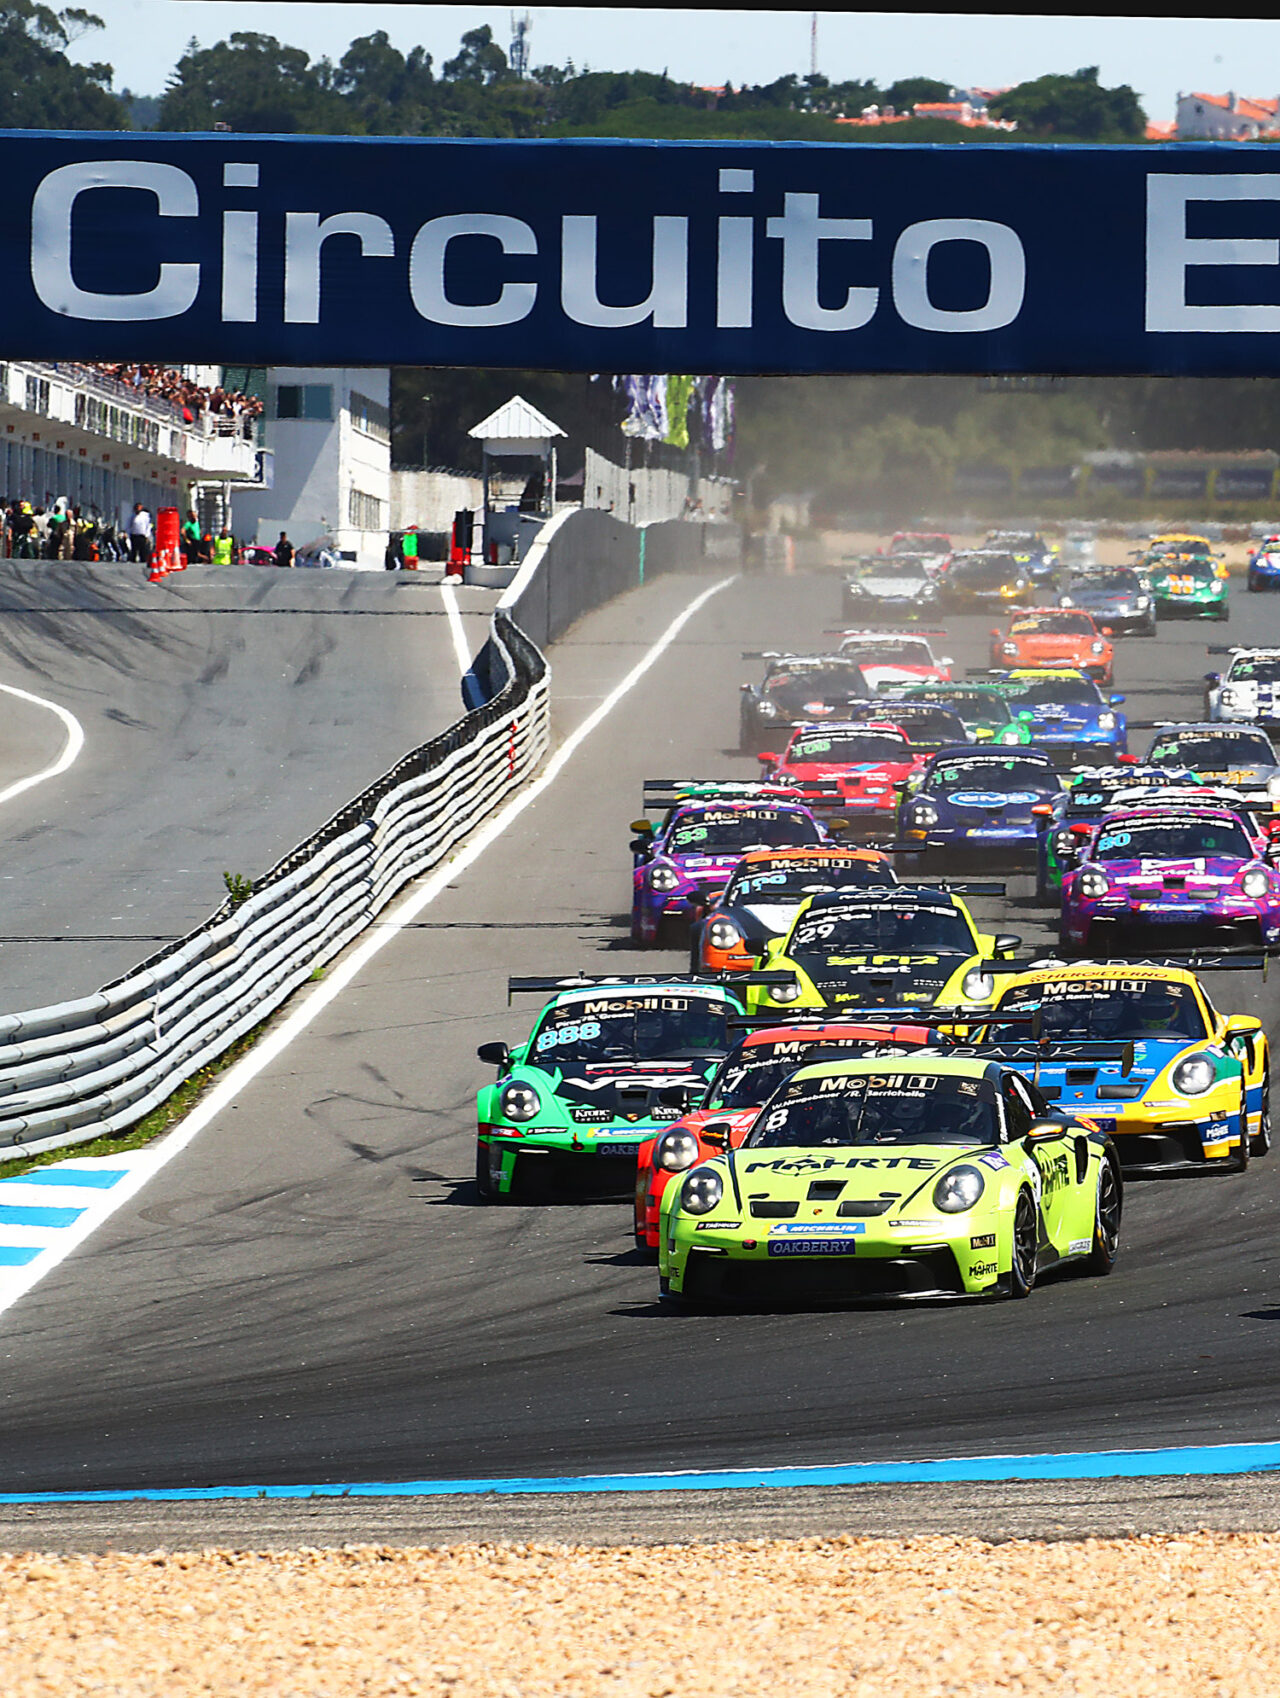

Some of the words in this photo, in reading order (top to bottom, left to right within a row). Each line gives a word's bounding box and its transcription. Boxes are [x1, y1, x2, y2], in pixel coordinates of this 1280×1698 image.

[31, 160, 1026, 332] Circuito
[704, 811, 757, 821] Mobil
[771, 859, 829, 869] Mobil
[806, 904, 958, 918] PORSCHE
[798, 924, 835, 944] 29
[1043, 979, 1117, 995] Mobil
[584, 998, 658, 1014] Mobil
[537, 1022, 601, 1052] 888
[722, 1070, 748, 1093] 7
[820, 1075, 903, 1091] Mobil
[766, 1109, 789, 1131] 8
[789, 1224, 858, 1233] MICHELIN
[773, 1241, 850, 1255] OAKBERRY
